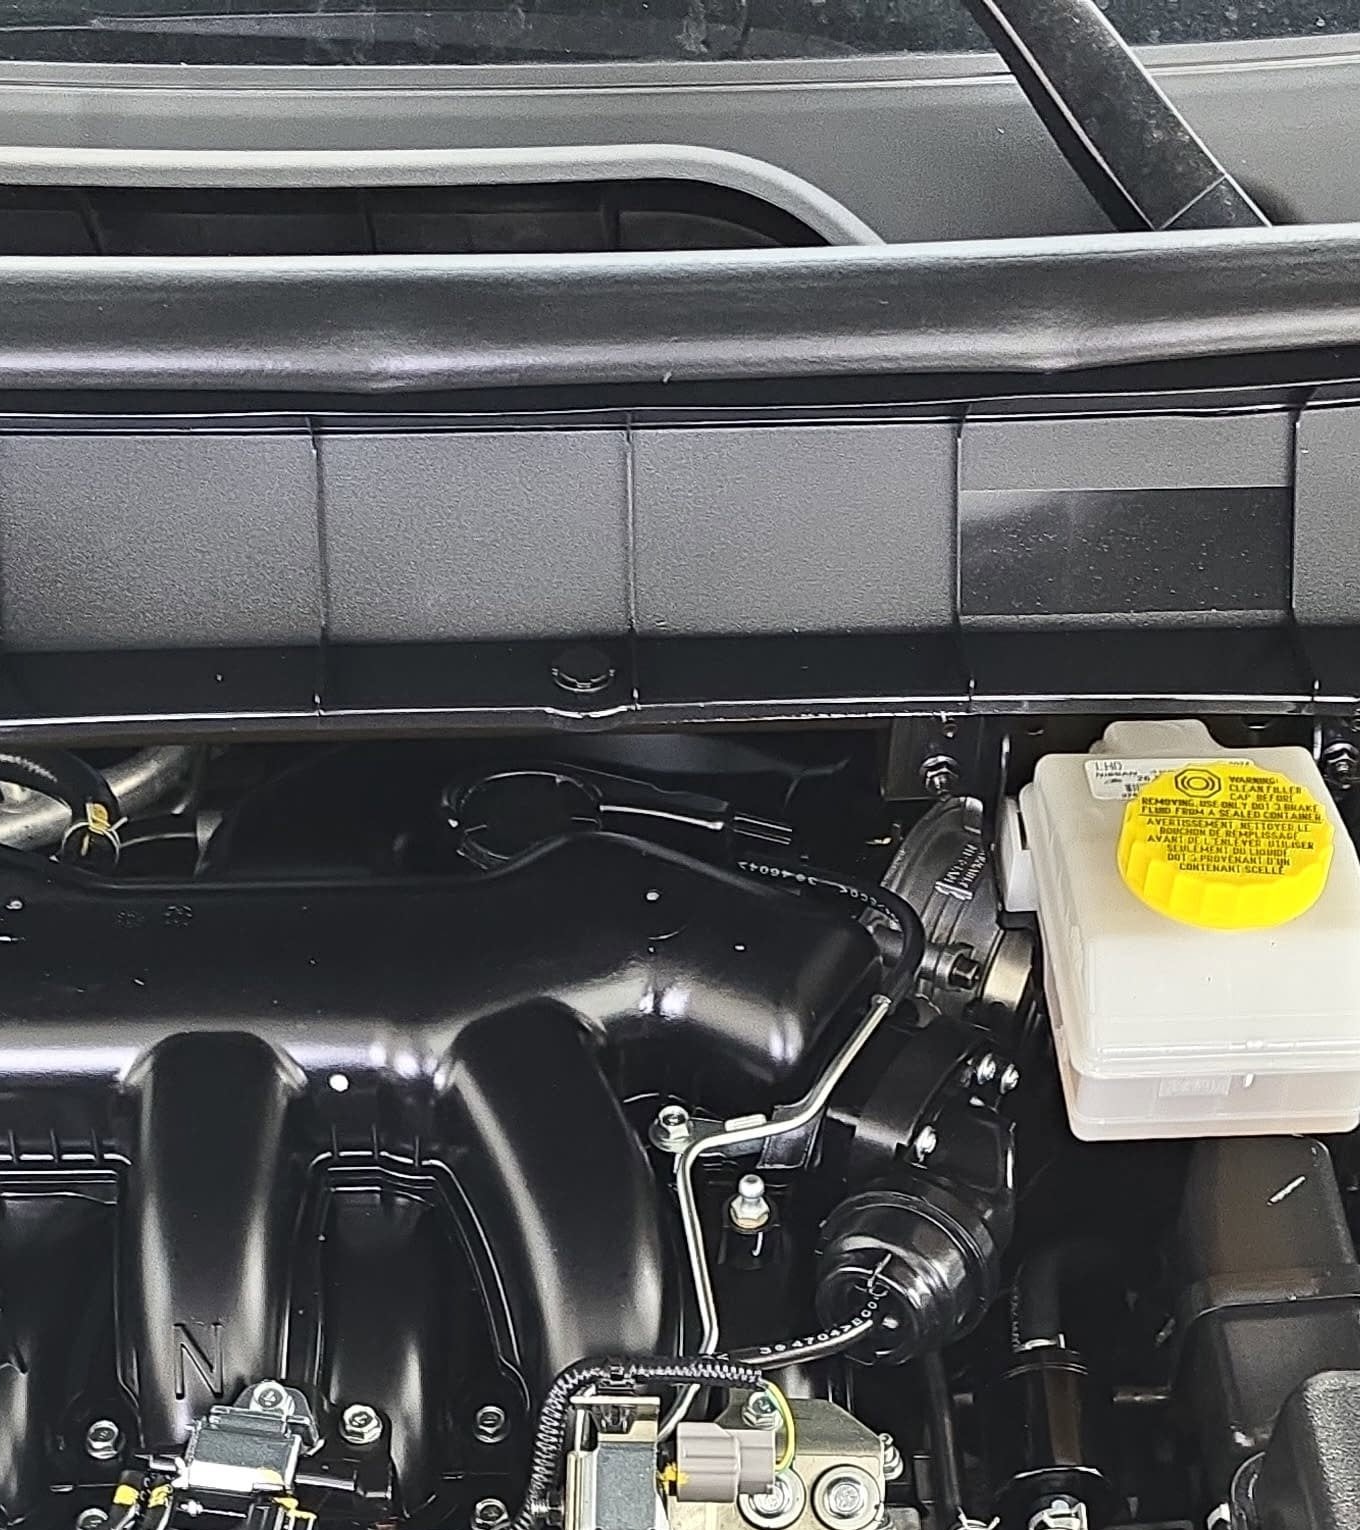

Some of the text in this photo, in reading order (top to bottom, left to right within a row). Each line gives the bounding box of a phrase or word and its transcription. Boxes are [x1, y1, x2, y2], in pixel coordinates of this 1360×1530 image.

[1230, 793, 1293, 802] CAP BEFORE
[1199, 800, 1217, 808] USE
[1220, 801, 1247, 809] ONLY
[1251, 802, 1270, 810] DOT
[1284, 803, 1317, 812] BRAKE
[1141, 806, 1171, 814] FLUID
[1175, 807, 1204, 815] FROM
[1219, 809, 1260, 818] SEALED
[1159, 827, 1206, 836] BOUCHON
[1209, 829, 1220, 837] DE
[1297, 824, 1309, 832] LE
[1147, 835, 1183, 843] AVANT
[1166, 844, 1287, 856] SEULEMENT DU LIQUIDE
[1167, 853, 1186, 861] DOT
[1200, 854, 1262, 865] PROVENANT
[1179, 863, 1240, 873] CONTENANT
